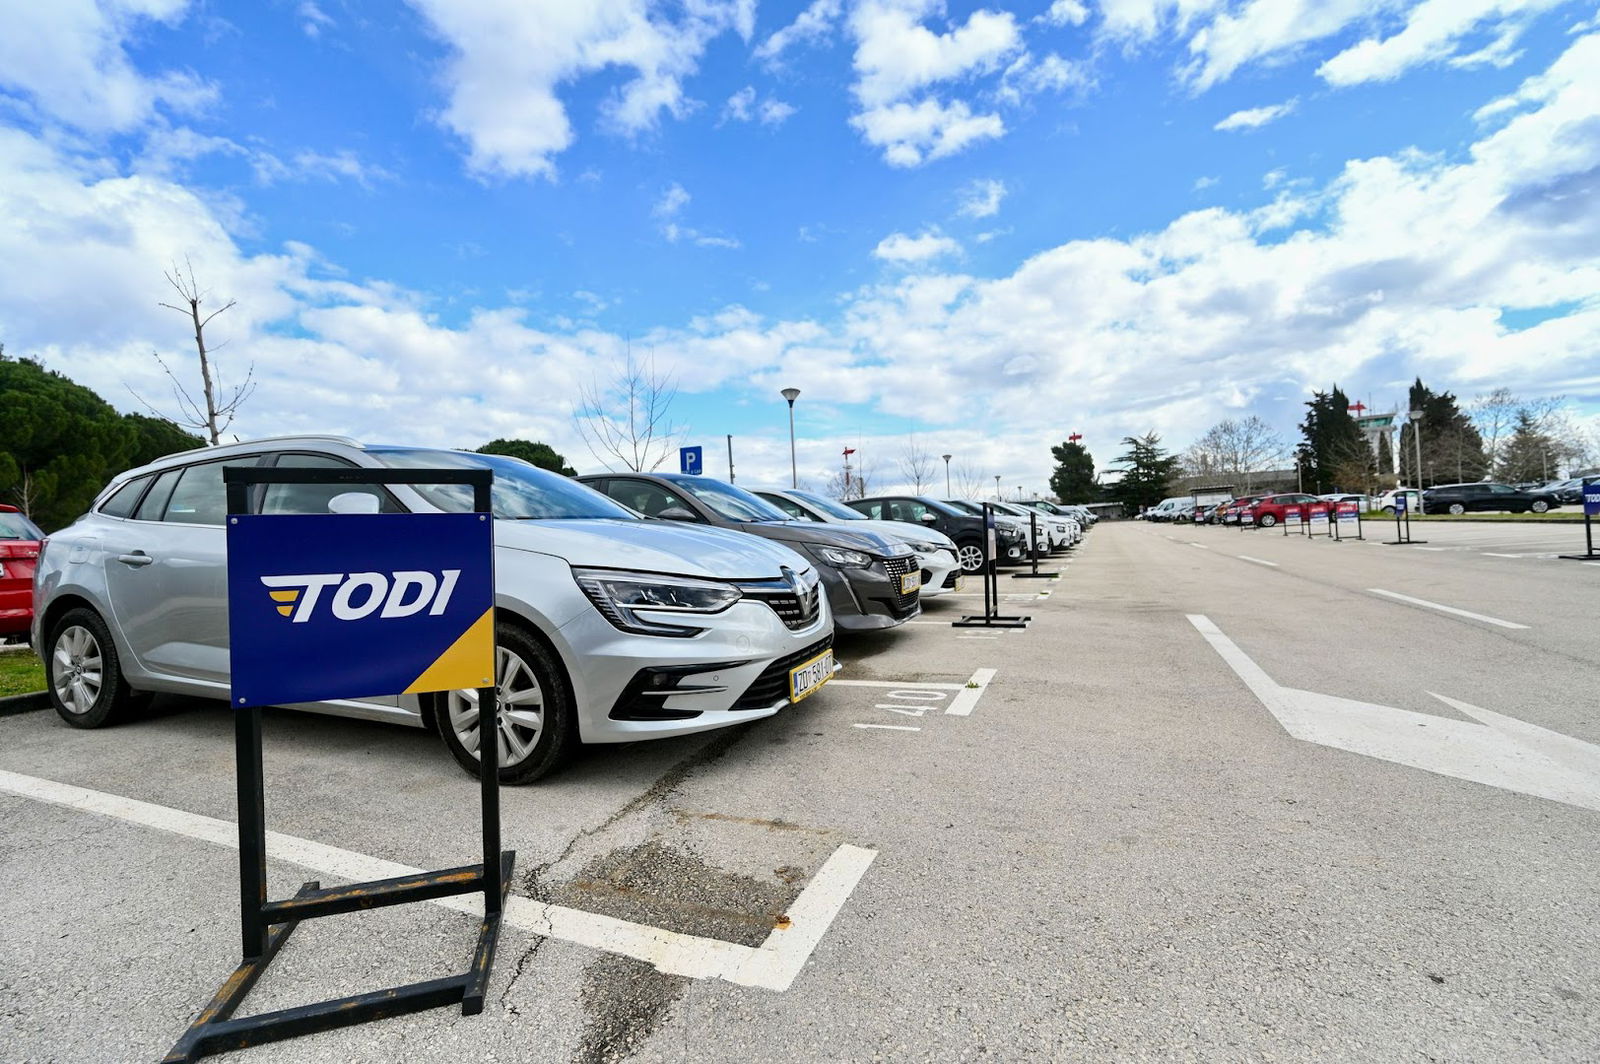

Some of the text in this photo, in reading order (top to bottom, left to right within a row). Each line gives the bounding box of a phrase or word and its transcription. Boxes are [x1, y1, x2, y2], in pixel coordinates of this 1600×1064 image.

[686, 452, 696, 472] P
[1584, 494, 1600, 503] TOD
[260, 569, 461, 623] TODI
[798, 670, 809, 692] ZD
[853, 690, 948, 732] 140
